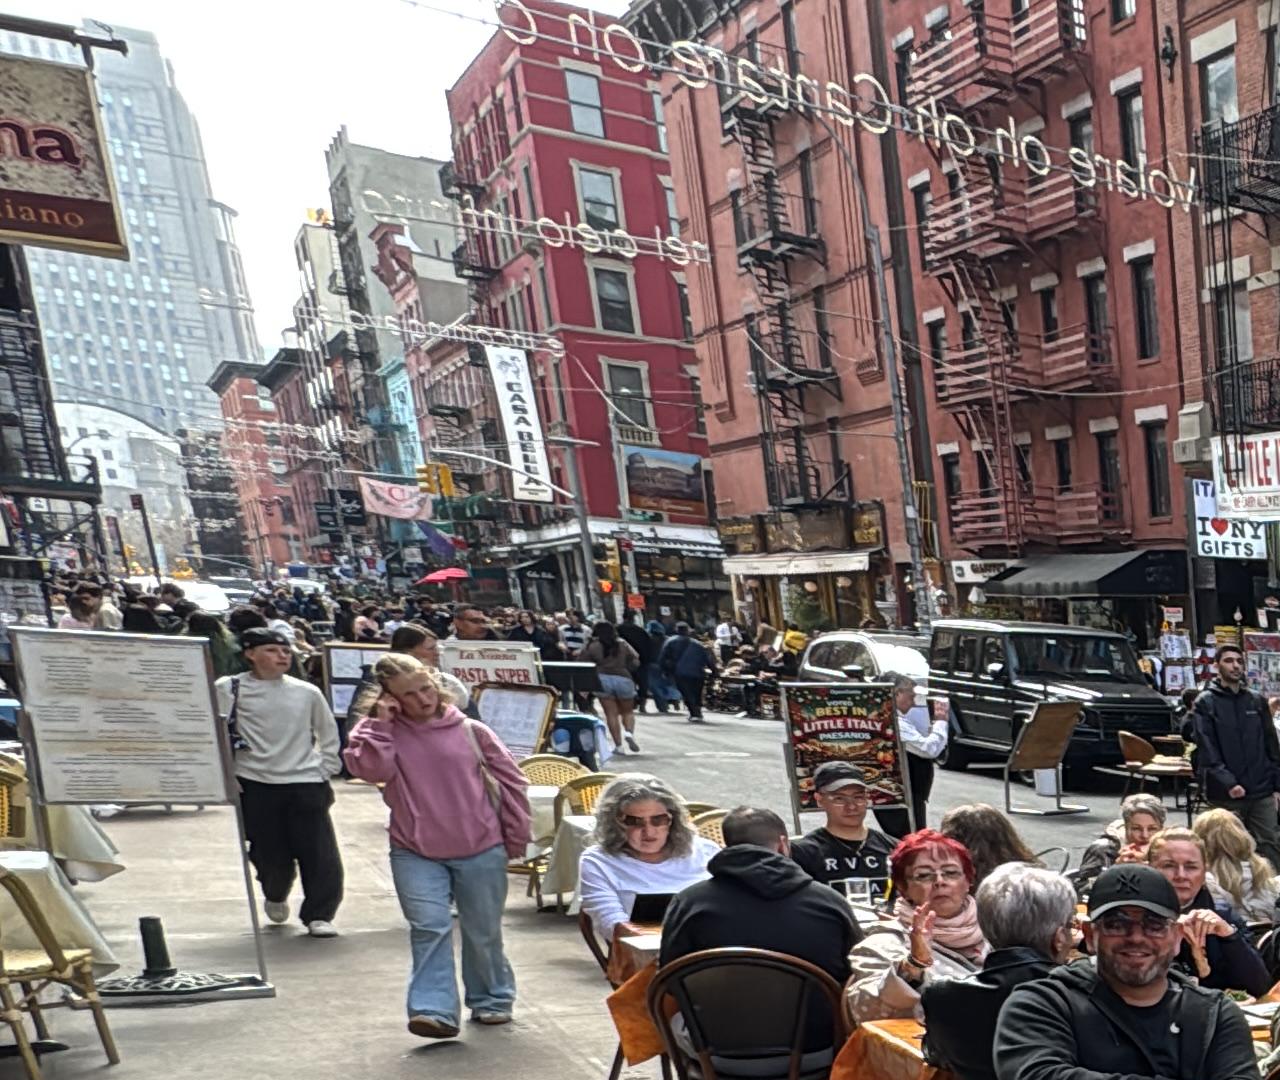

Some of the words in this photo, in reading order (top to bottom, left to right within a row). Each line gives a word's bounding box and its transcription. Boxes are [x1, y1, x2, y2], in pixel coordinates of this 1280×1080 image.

[0, 198, 85, 228] iano
[505, 381, 533, 427] CASA
[516, 430, 543, 487] BELLA
[1231, 520, 1264, 540] NY
[1200, 540, 1255, 556] GIFTS
[452, 667, 490, 683] PASTA
[494, 668, 531, 684] SUPER
[815, 706, 848, 717] BEST
[851, 706, 868, 717] IN
[803, 720, 845, 733] LITTLE
[846, 718, 883, 732] ITALY
[818, 732, 872, 741] PAESANOS
[824, 855, 891, 872] RVC
